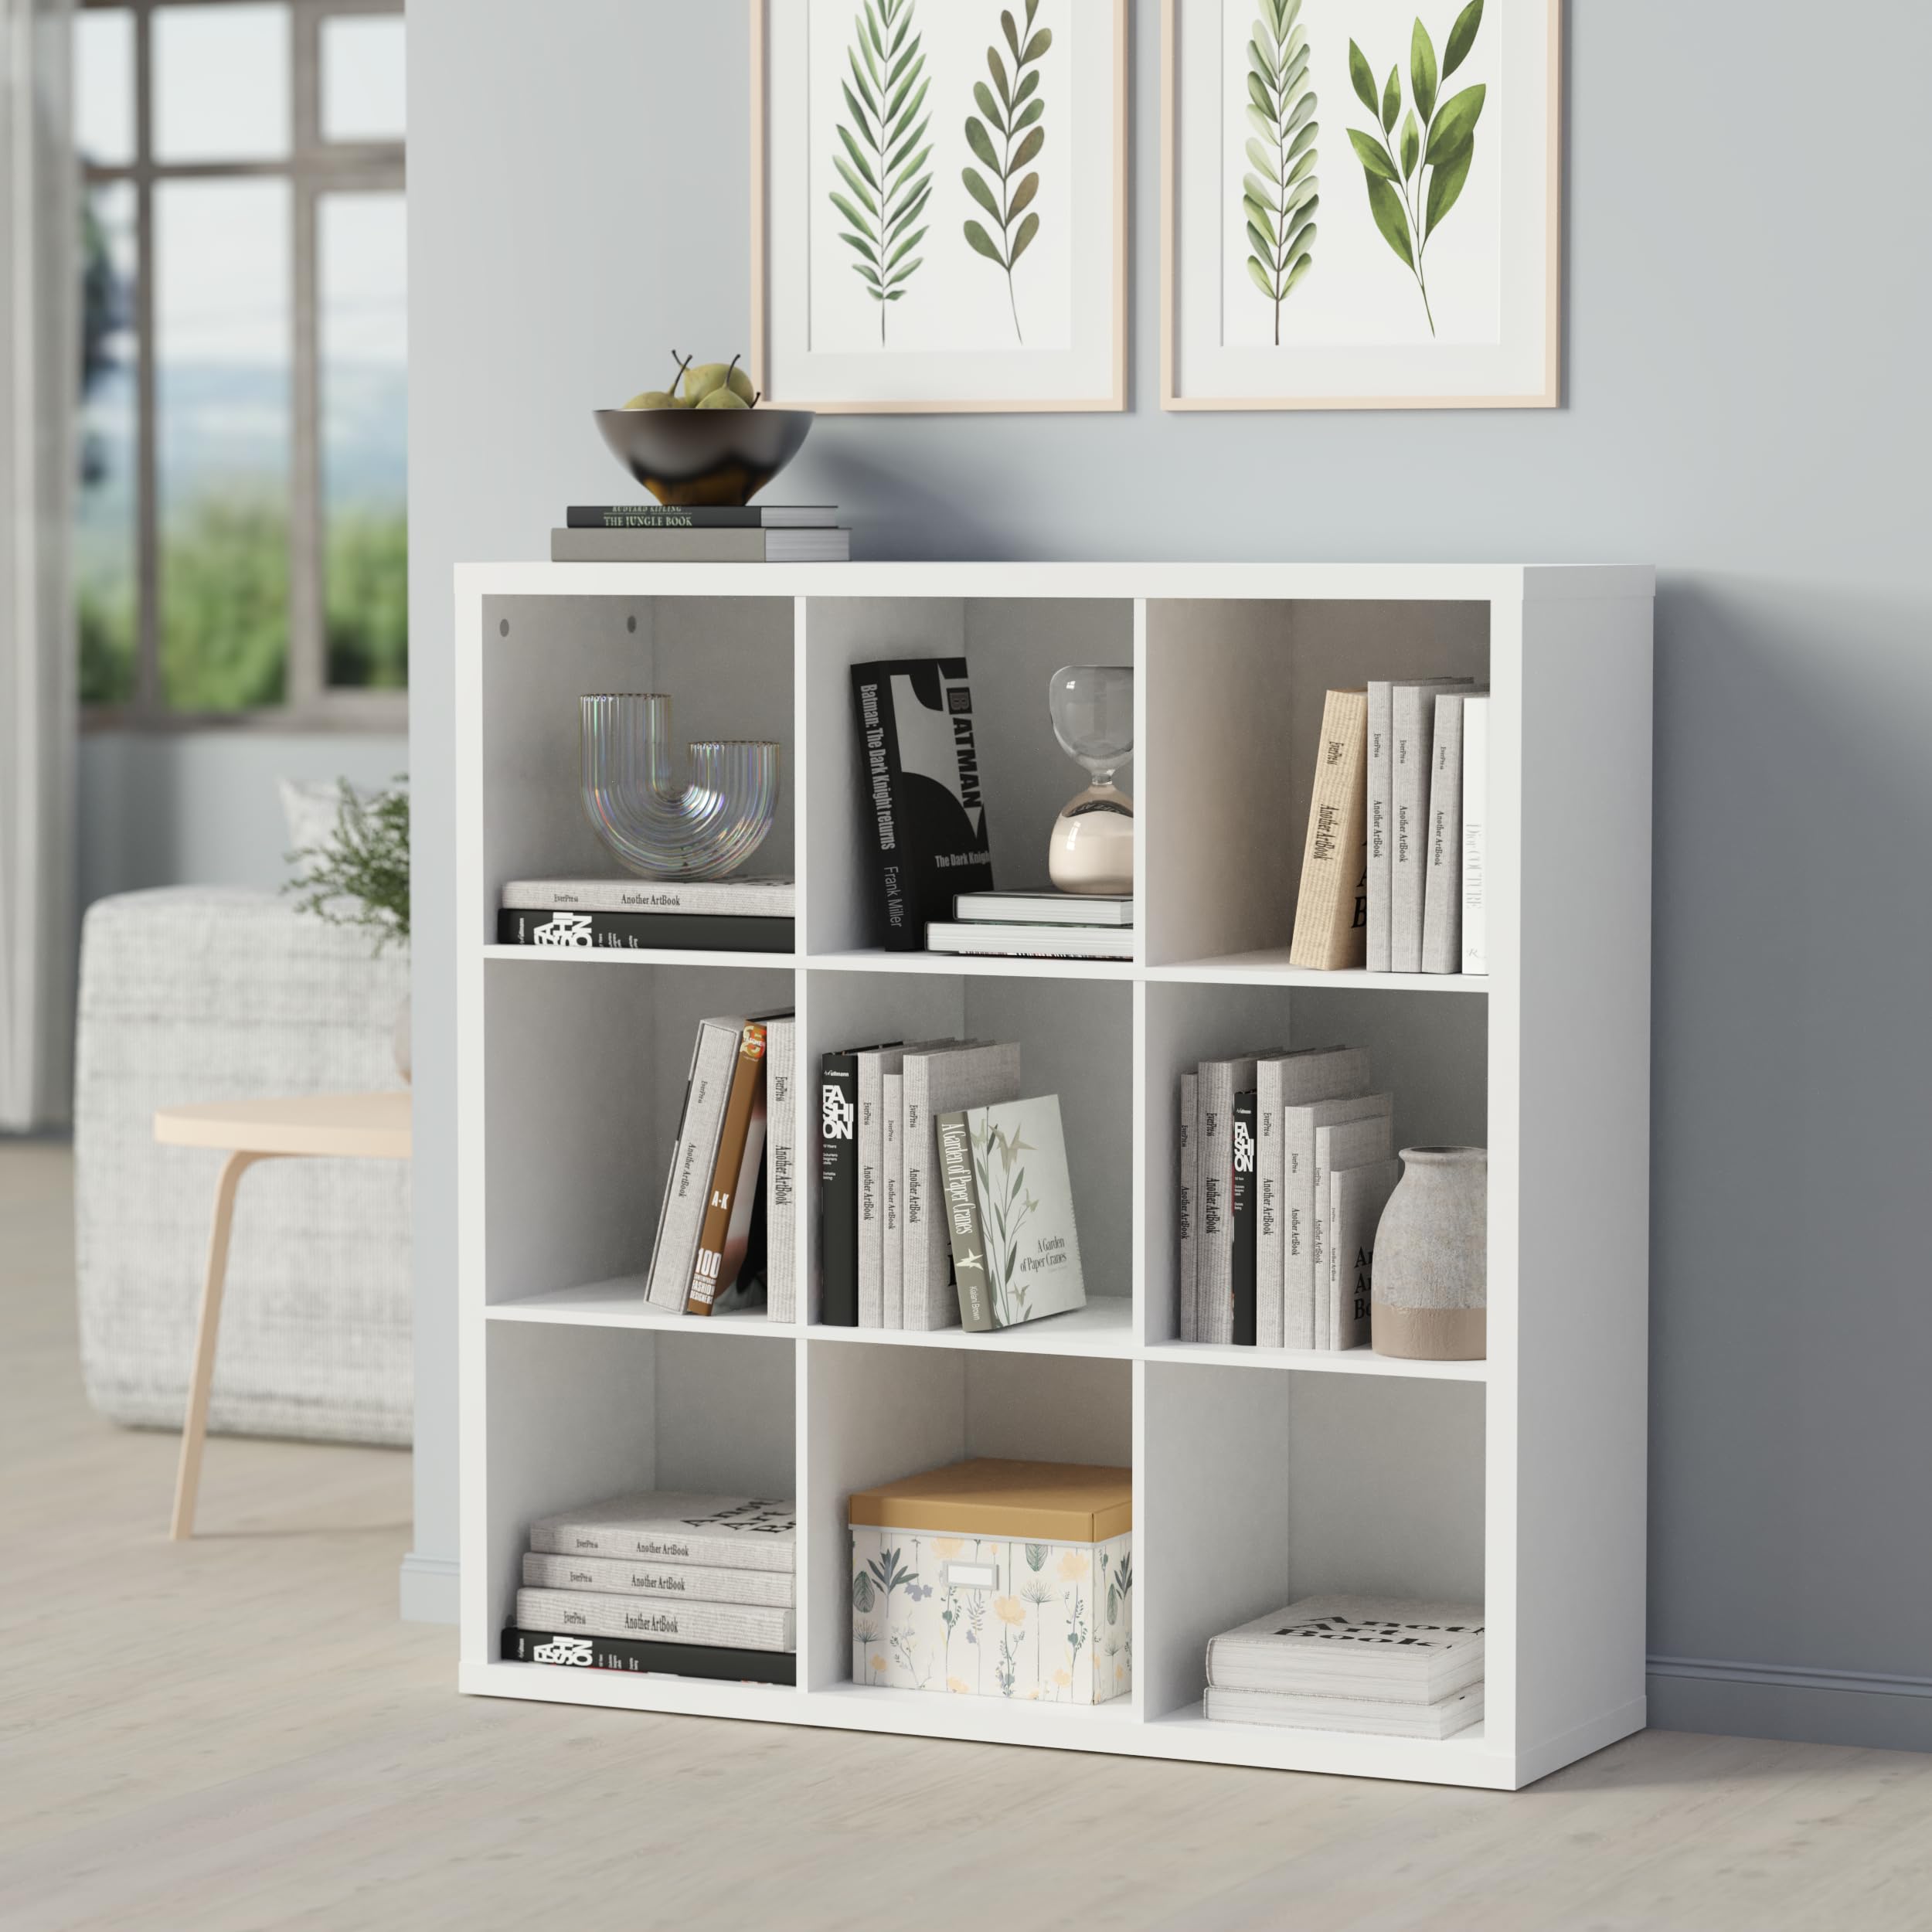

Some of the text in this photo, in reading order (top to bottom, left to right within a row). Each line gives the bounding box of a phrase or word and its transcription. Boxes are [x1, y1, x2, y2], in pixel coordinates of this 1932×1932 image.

[604, 515, 692, 527] THE JUNGLE BOOK
[947, 687, 983, 808] BATMAN
[860, 683, 896, 850] Batman: The Dark Knight returns
[1313, 804, 1339, 860] Another ArtBook
[1373, 800, 1383, 858] Another ArtBook
[1399, 805, 1409, 863] Another ArtBook
[1434, 811, 1444, 866] Another ArtBook
[934, 855, 950, 868] The
[951, 853, 968, 866] Dark
[621, 894, 680, 906] Another ArtBook
[884, 866, 904, 927] Frank Miller
[775, 1077, 787, 1101] EverPress
[1206, 1112, 1217, 1137] EverPress
[943, 1131, 968, 1164] Garden
[679, 1142, 697, 1197] Another ArtBook
[775, 1145, 792, 1206] Another ArtBook
[947, 1165, 971, 1175] of
[863, 1165, 874, 1220] Another ArtBook
[910, 1168, 920, 1223] Another ArtBook
[944, 1175, 972, 1202] Paper
[953, 1202, 976, 1234] Cranes
[1181, 1186, 1190, 1239] Another ArtBook
[1206, 1177, 1220, 1234] Another ArtBook
[1264, 1178, 1274, 1236] Another ArtBook
[1038, 1236, 1065, 1253] A Garden
[1291, 1208, 1300, 1256] Another ArtBook
[695, 1247, 723, 1280] 100
[1020, 1258, 1026, 1272] of
[1027, 1257, 1045, 1273] Paper
[1046, 1252, 1066, 1266] Cranes
[971, 1303, 981, 1321] Brown
[636, 1542, 689, 1556] Another ArtBook
[631, 1574, 685, 1590] Another ArtBook
[624, 1613, 679, 1633] Another ArtBook
[1272, 1628, 1440, 1647] Book
[1286, 1623, 1405, 1637] Art
